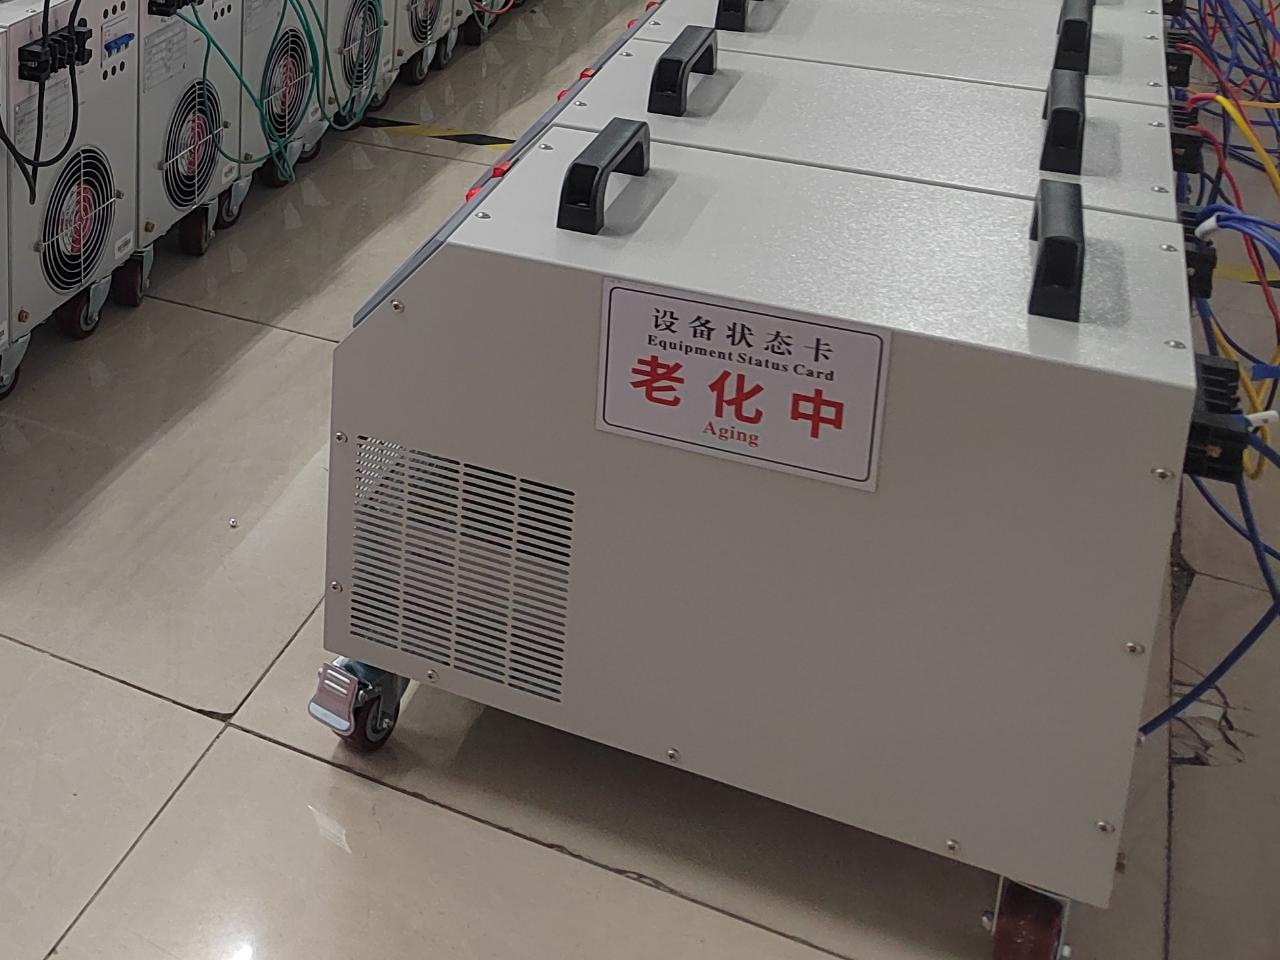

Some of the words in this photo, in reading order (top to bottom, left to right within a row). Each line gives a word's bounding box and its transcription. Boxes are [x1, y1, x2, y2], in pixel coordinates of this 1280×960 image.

[647, 334, 733, 362] Equipment
[737, 352, 789, 373] Status
[794, 363, 834, 382] Card
[651, 307, 834, 363] 设备状态卡
[630, 355, 845, 439] 老化中
[703, 420, 759, 447] Aging
